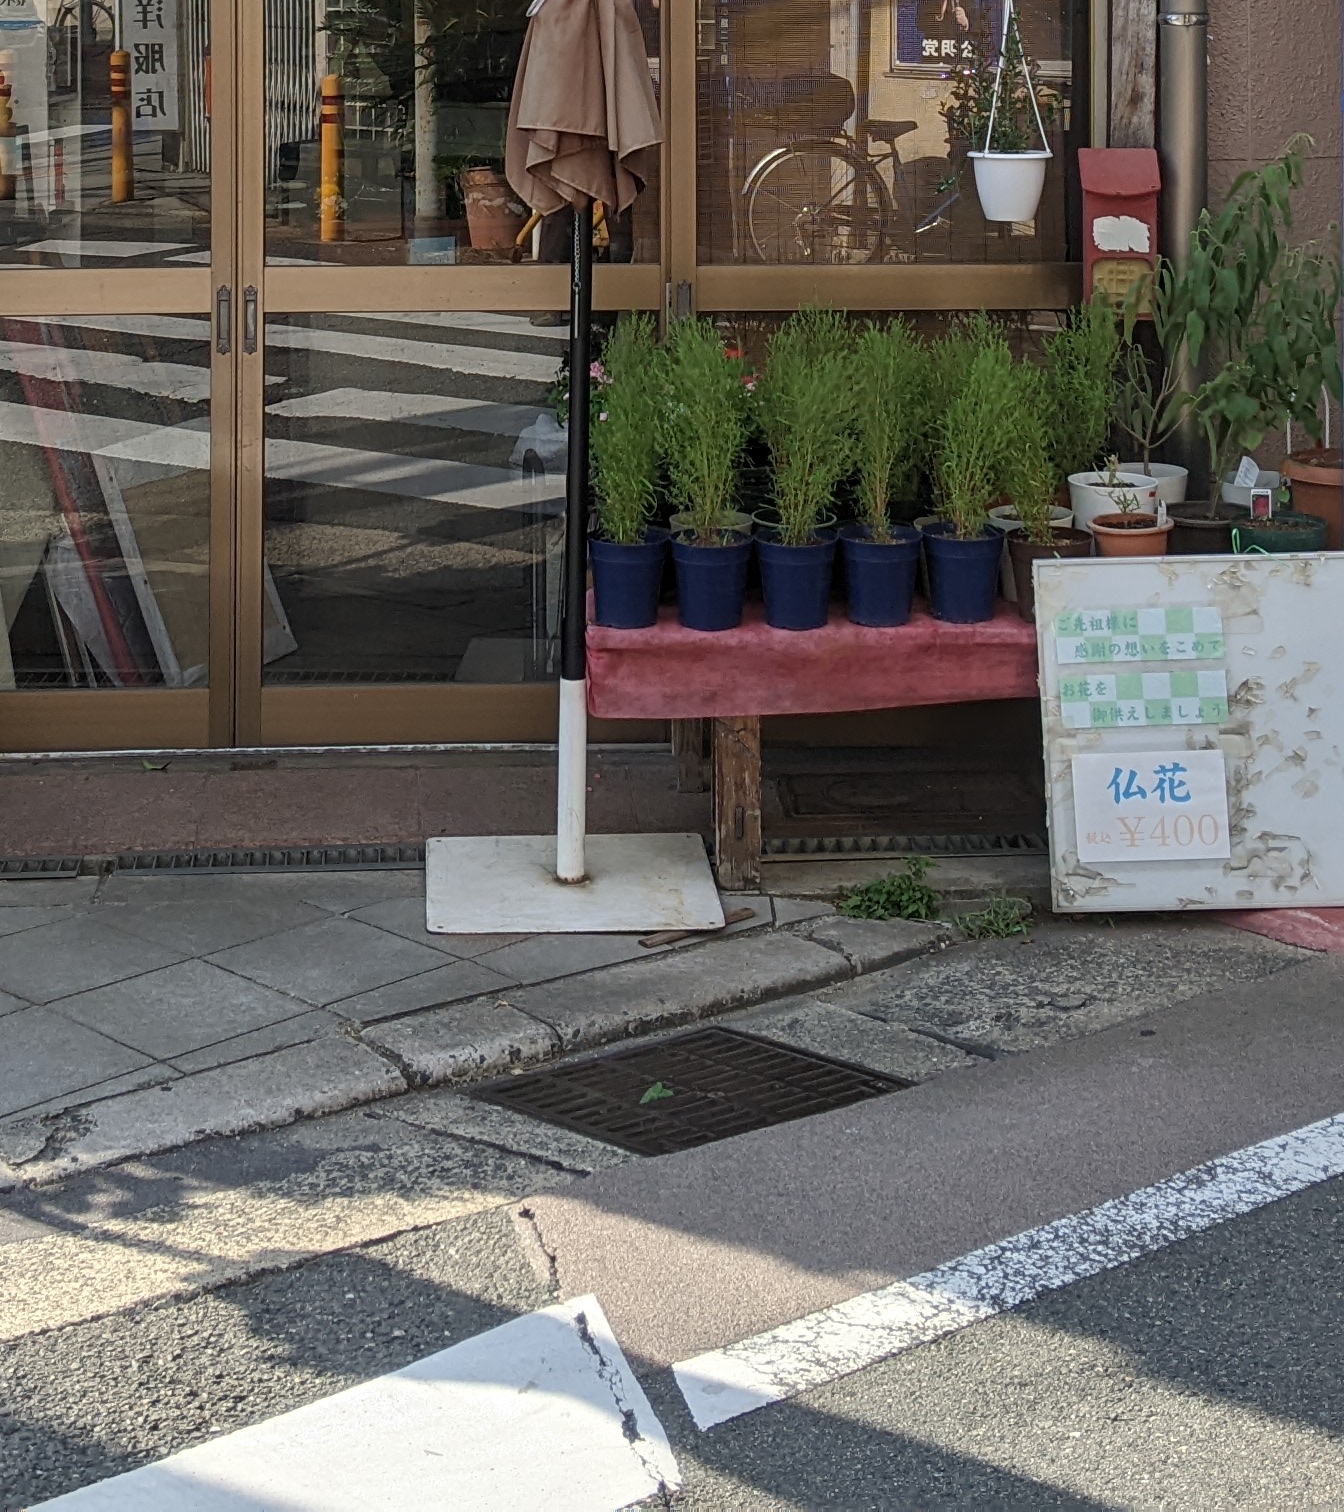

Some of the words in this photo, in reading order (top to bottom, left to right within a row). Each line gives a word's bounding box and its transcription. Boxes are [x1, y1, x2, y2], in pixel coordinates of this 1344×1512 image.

[1074, 639, 1221, 659] 感謝の想いをこめて
[1062, 680, 1106, 698] お花を
[1092, 703, 1222, 723] 御供えしましょう
[1106, 762, 1192, 805] 仏花
